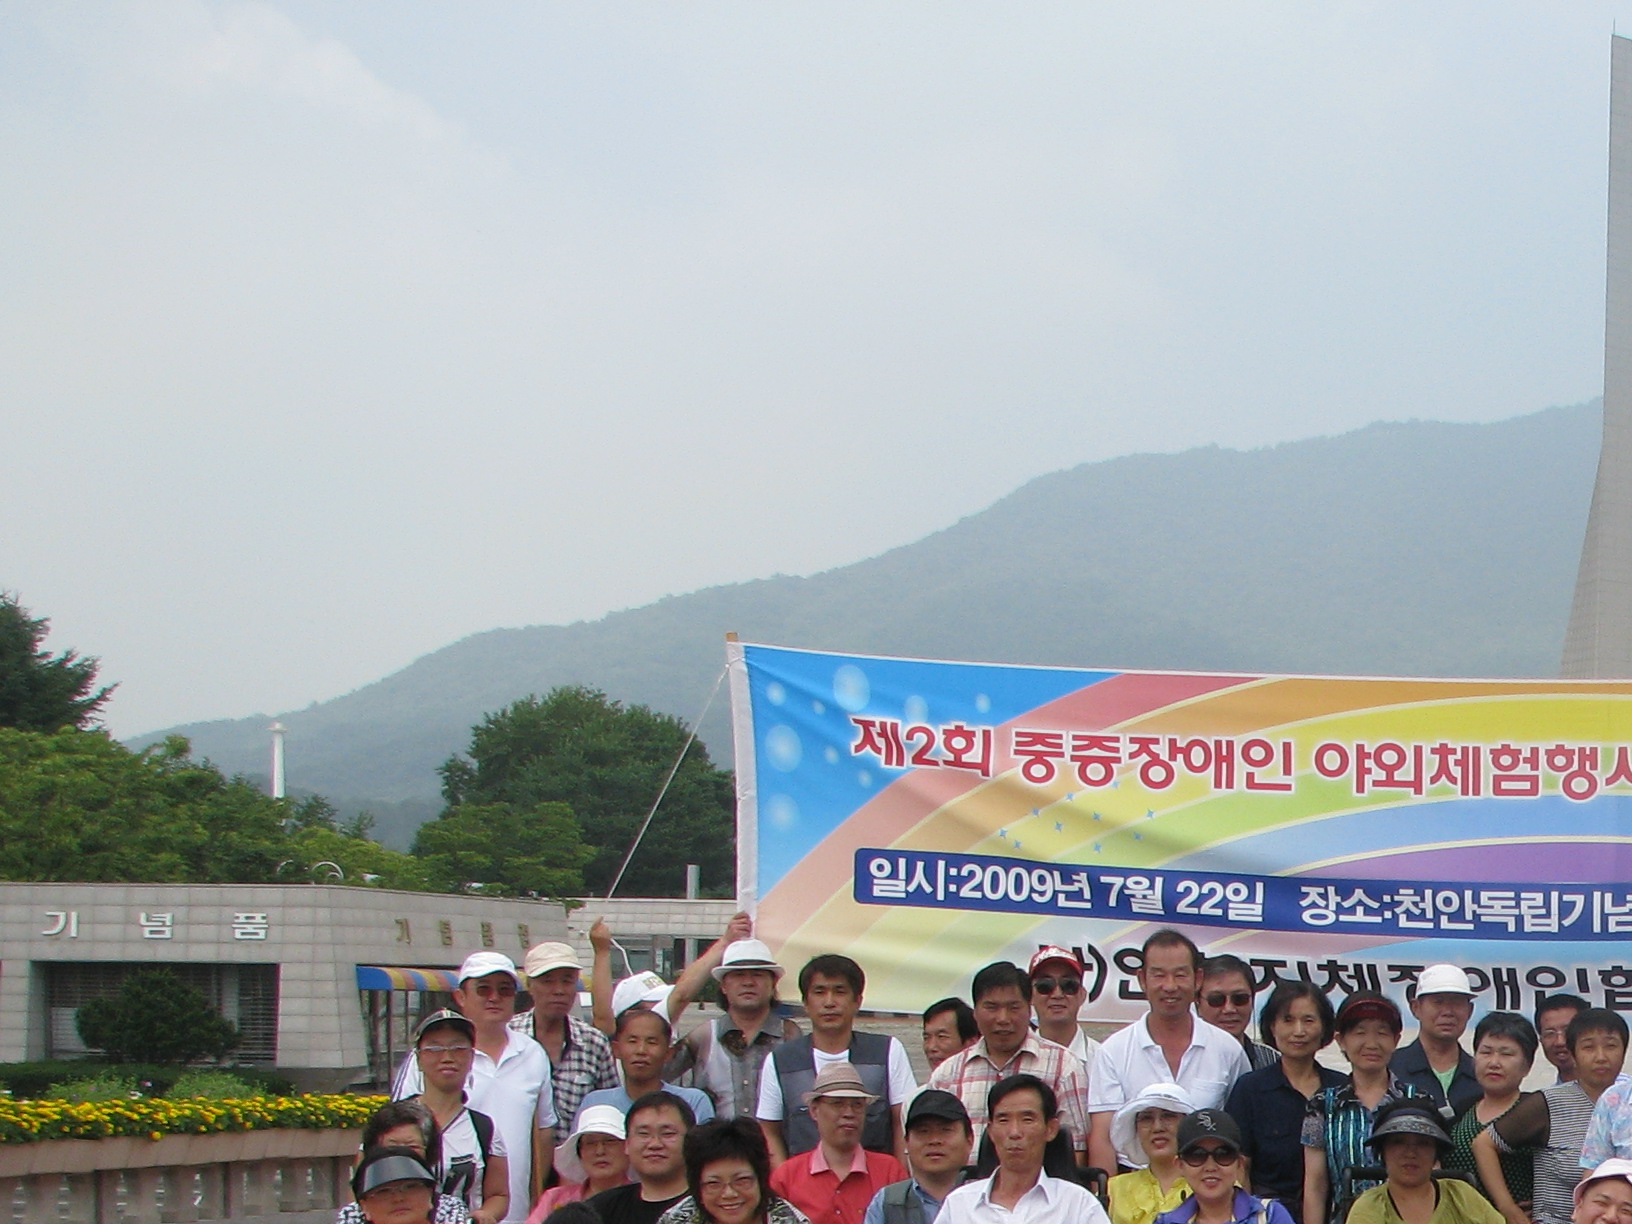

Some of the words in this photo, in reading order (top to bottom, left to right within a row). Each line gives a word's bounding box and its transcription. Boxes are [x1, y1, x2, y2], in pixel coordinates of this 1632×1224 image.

[852, 716, 992, 777] 제2회
[1012, 729, 1296, 792] 중증장애인
[869, 857, 1092, 909] 일시:2009년
[1099, 875, 1165, 915] 7월
[1175, 880, 1265, 923] 22일
[42, 910, 270, 941] 기념품
